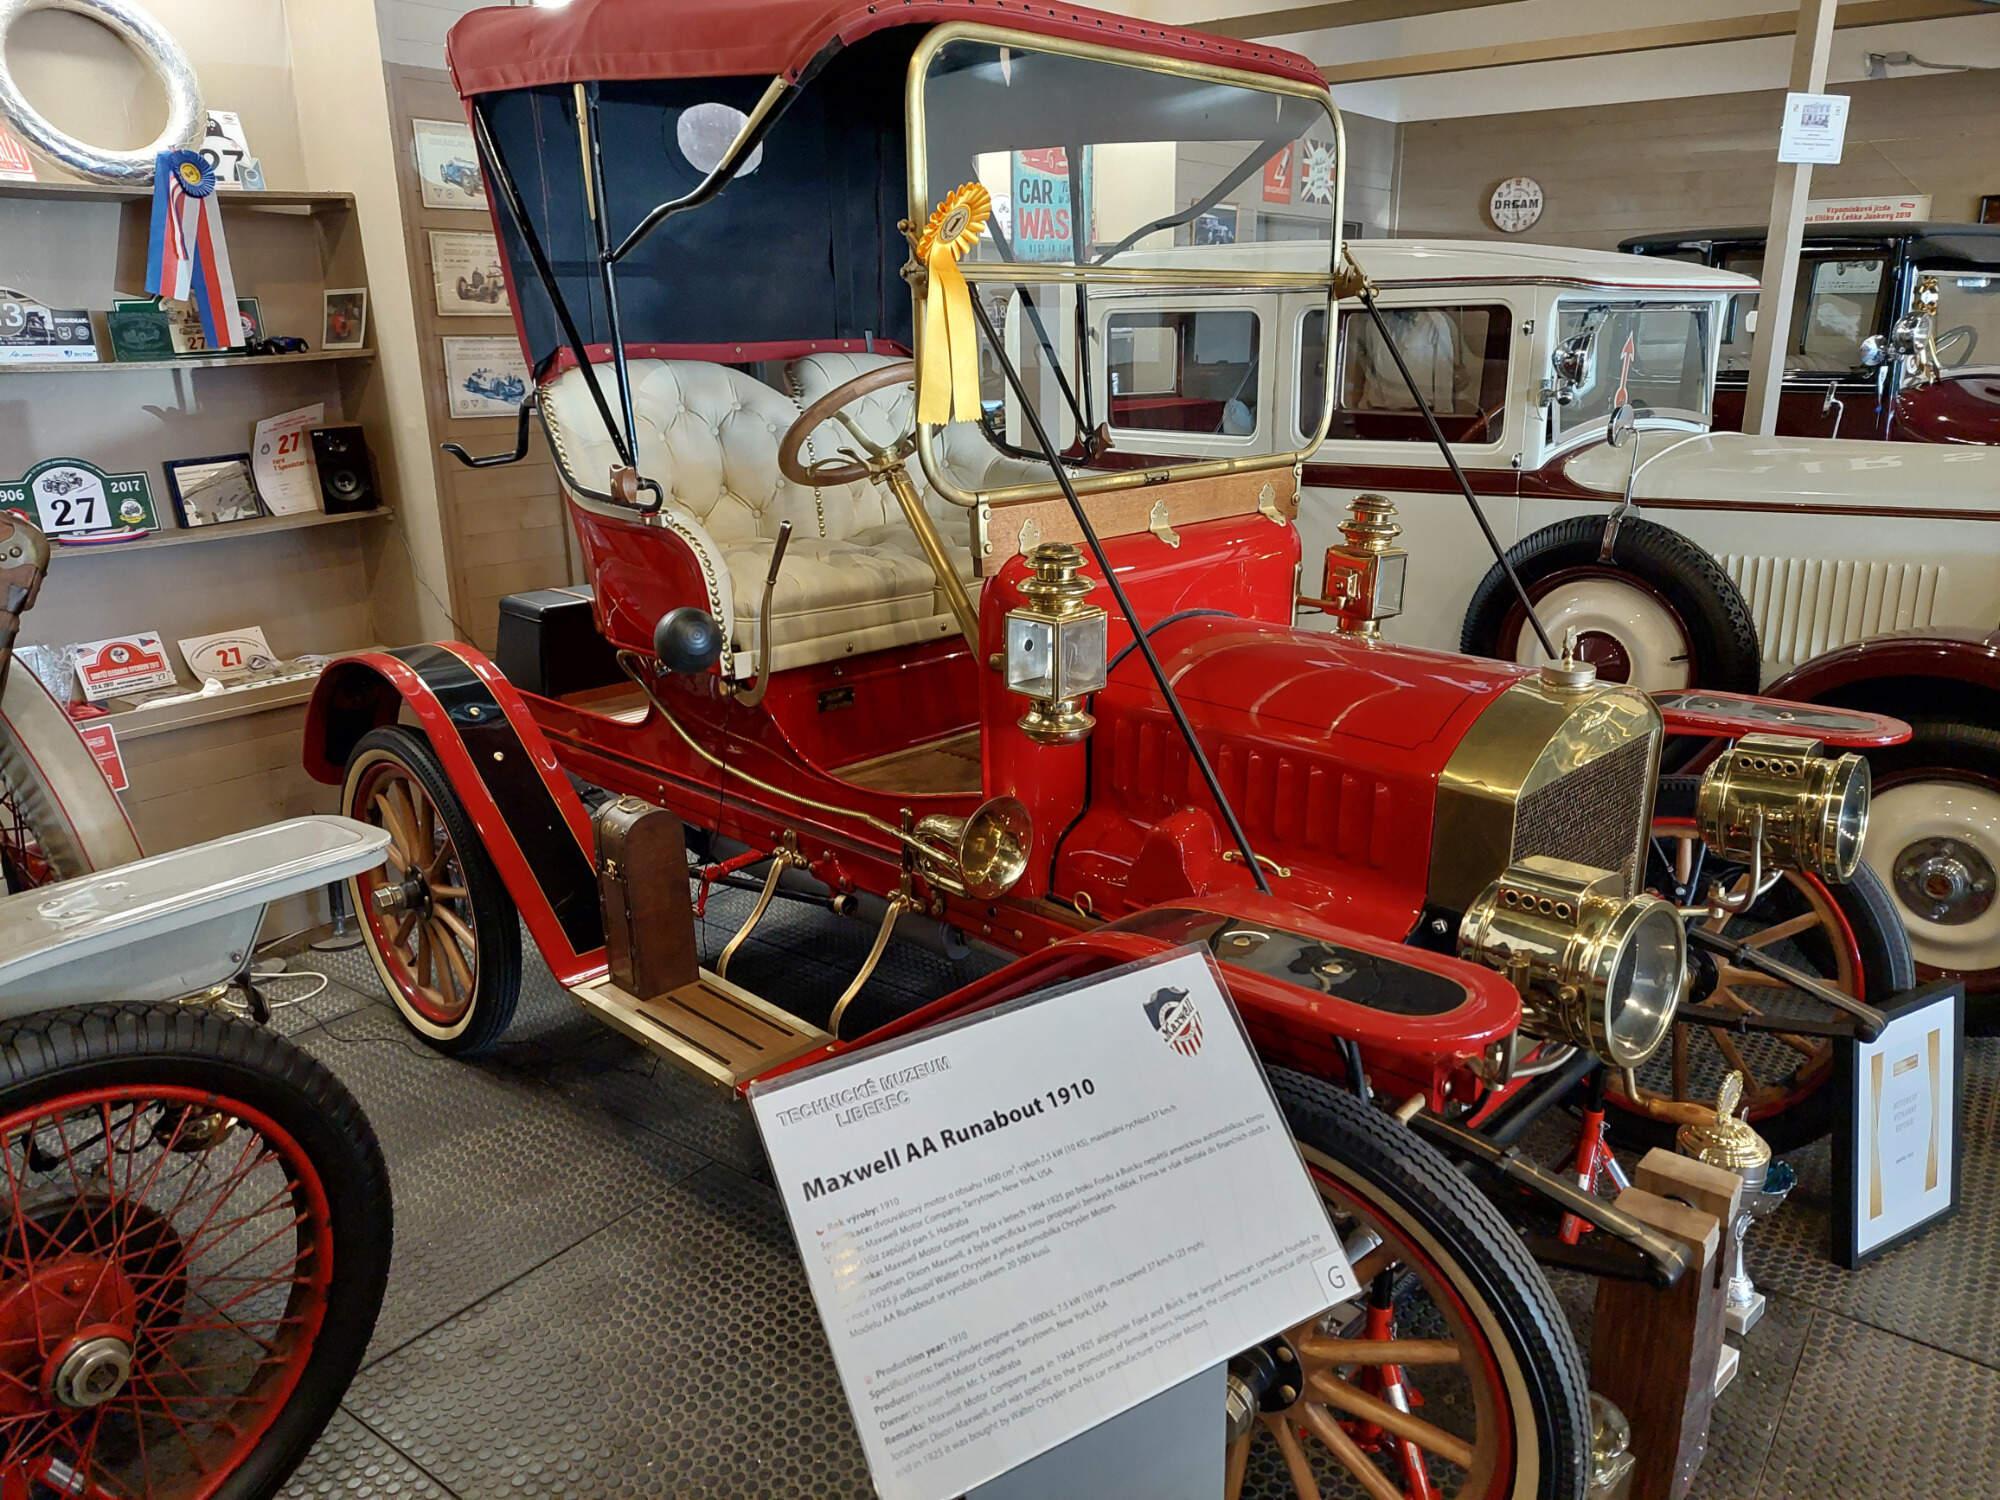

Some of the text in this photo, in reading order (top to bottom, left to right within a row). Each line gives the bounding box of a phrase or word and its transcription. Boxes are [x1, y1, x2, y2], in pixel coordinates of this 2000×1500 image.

[1020, 178, 1053, 204] CAR
[1494, 198, 1539, 210] DREAM
[949, 217, 962, 233] 1
[1018, 207, 1070, 241] WAS
[0, 303, 23, 327] 3
[187, 336, 206, 351] 27
[278, 431, 299, 455] 27
[0, 489, 25, 502] 906
[110, 480, 141, 493] 2017
[50, 497, 96, 527] 27
[216, 646, 242, 668] 27
[1161, 997, 1195, 1042] Maxwell
[776, 1055, 951, 1127] TECHNICKÉ MUZEUM
[835, 1089, 909, 1127] LIBEREC
[801, 1077, 1095, 1201] Maxwell AA Runabout 1910
[879, 1196, 900, 1210] 1910
[898, 1219, 923, 1234] Motor
[1036, 1165, 1053, 1178] USA
[917, 1244, 942, 1259] Motor
[1325, 1265, 1346, 1290] G
[874, 1330, 968, 1378] Production year: 1910
[883, 1420, 925, 1445] Remarks:
